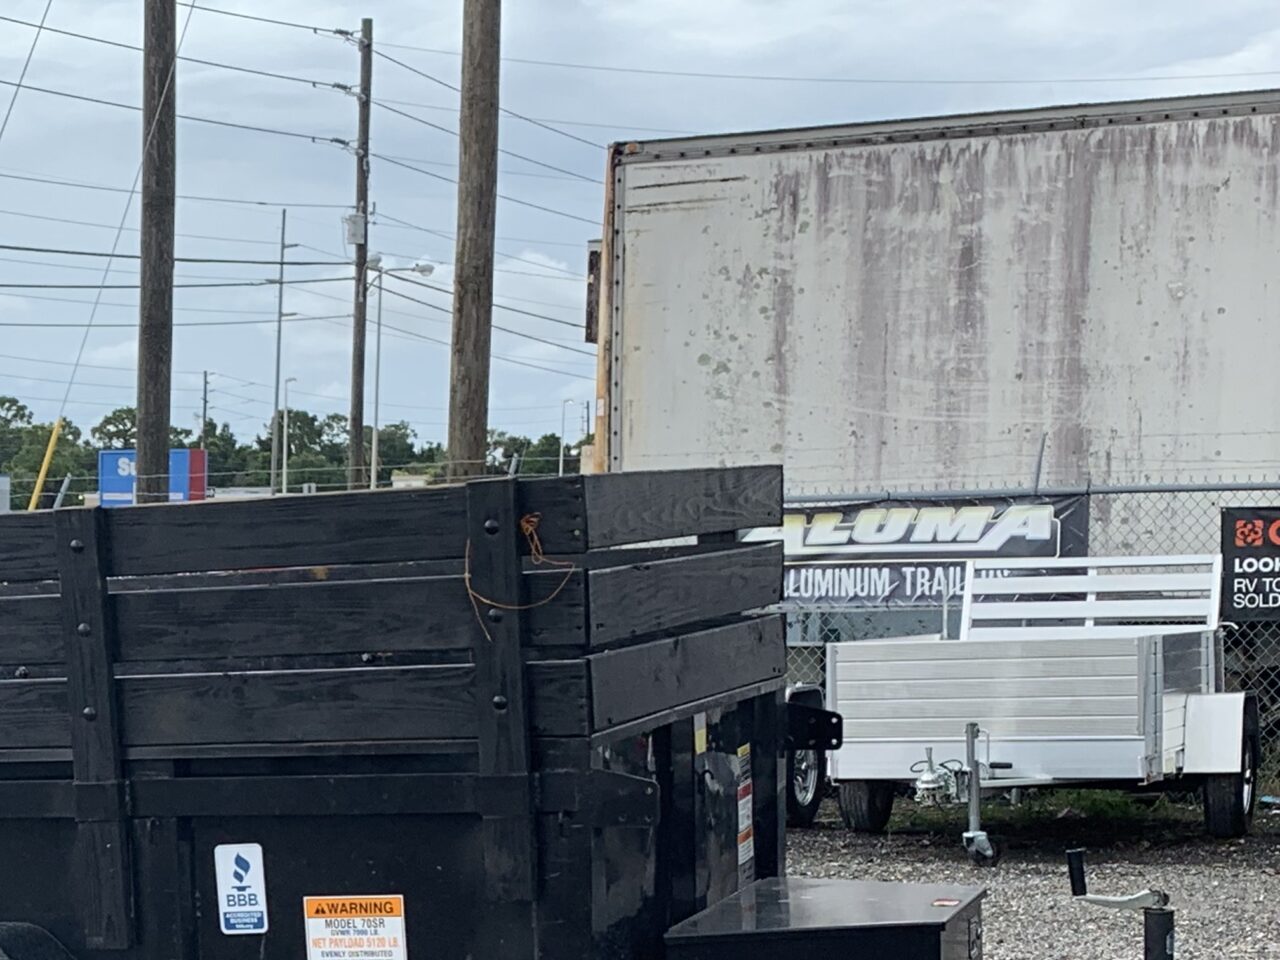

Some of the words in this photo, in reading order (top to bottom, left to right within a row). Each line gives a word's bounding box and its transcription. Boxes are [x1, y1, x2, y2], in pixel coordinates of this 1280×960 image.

[1234, 578, 1258, 592] RV
[226, 893, 258, 907] BBB
[326, 901, 394, 914] WARNING
[325, 919, 357, 929] MODEL
[361, 918, 386, 929] 70SR
[312, 938, 326, 949] NET
[329, 937, 365, 949] PAYLOAD
